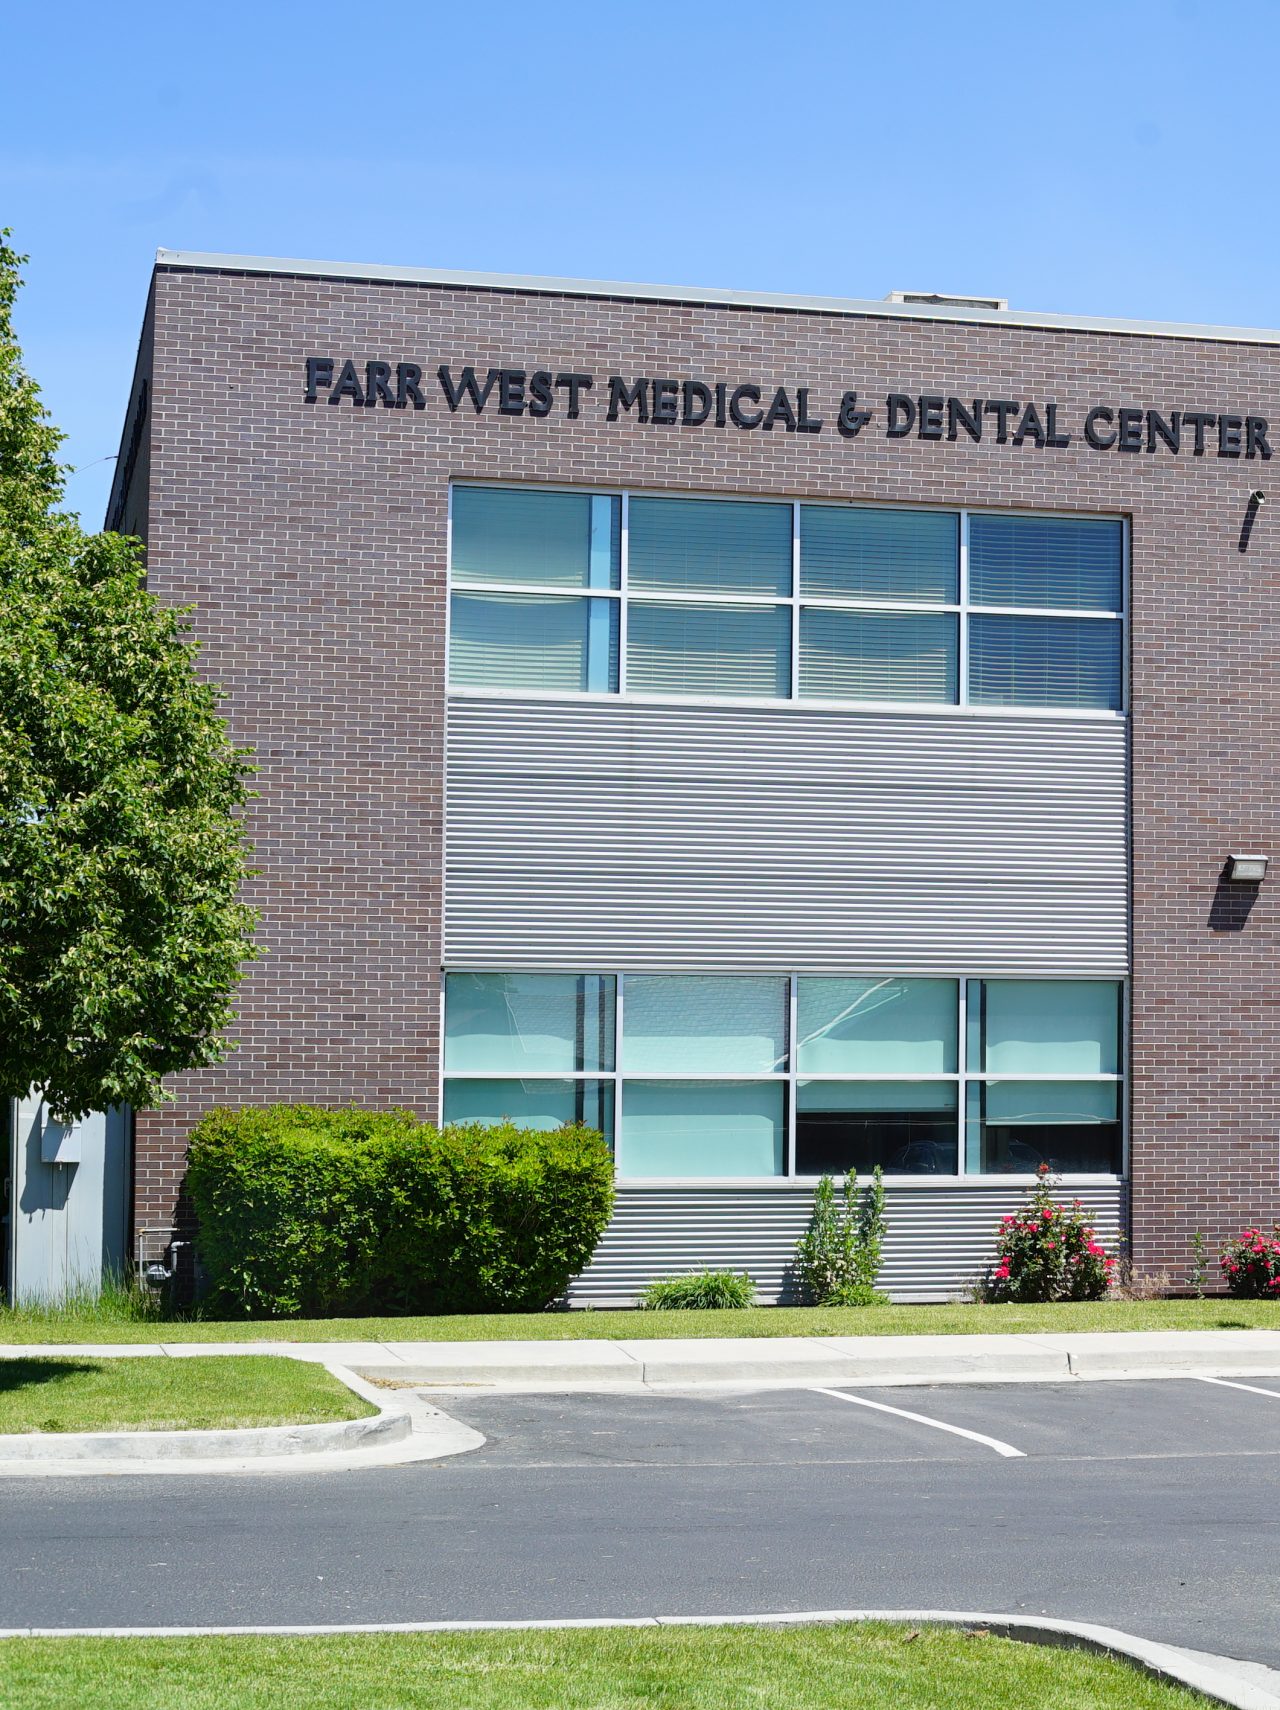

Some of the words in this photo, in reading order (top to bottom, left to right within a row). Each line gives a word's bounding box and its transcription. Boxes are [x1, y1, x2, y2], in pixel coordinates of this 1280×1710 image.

[304, 357, 426, 410] FARR
[437, 364, 592, 419] WEST
[606, 375, 822, 433] MEDICAL
[838, 391, 872, 438] &
[885, 394, 1071, 448] DENTAL
[1084, 406, 1273, 460] CENTER
